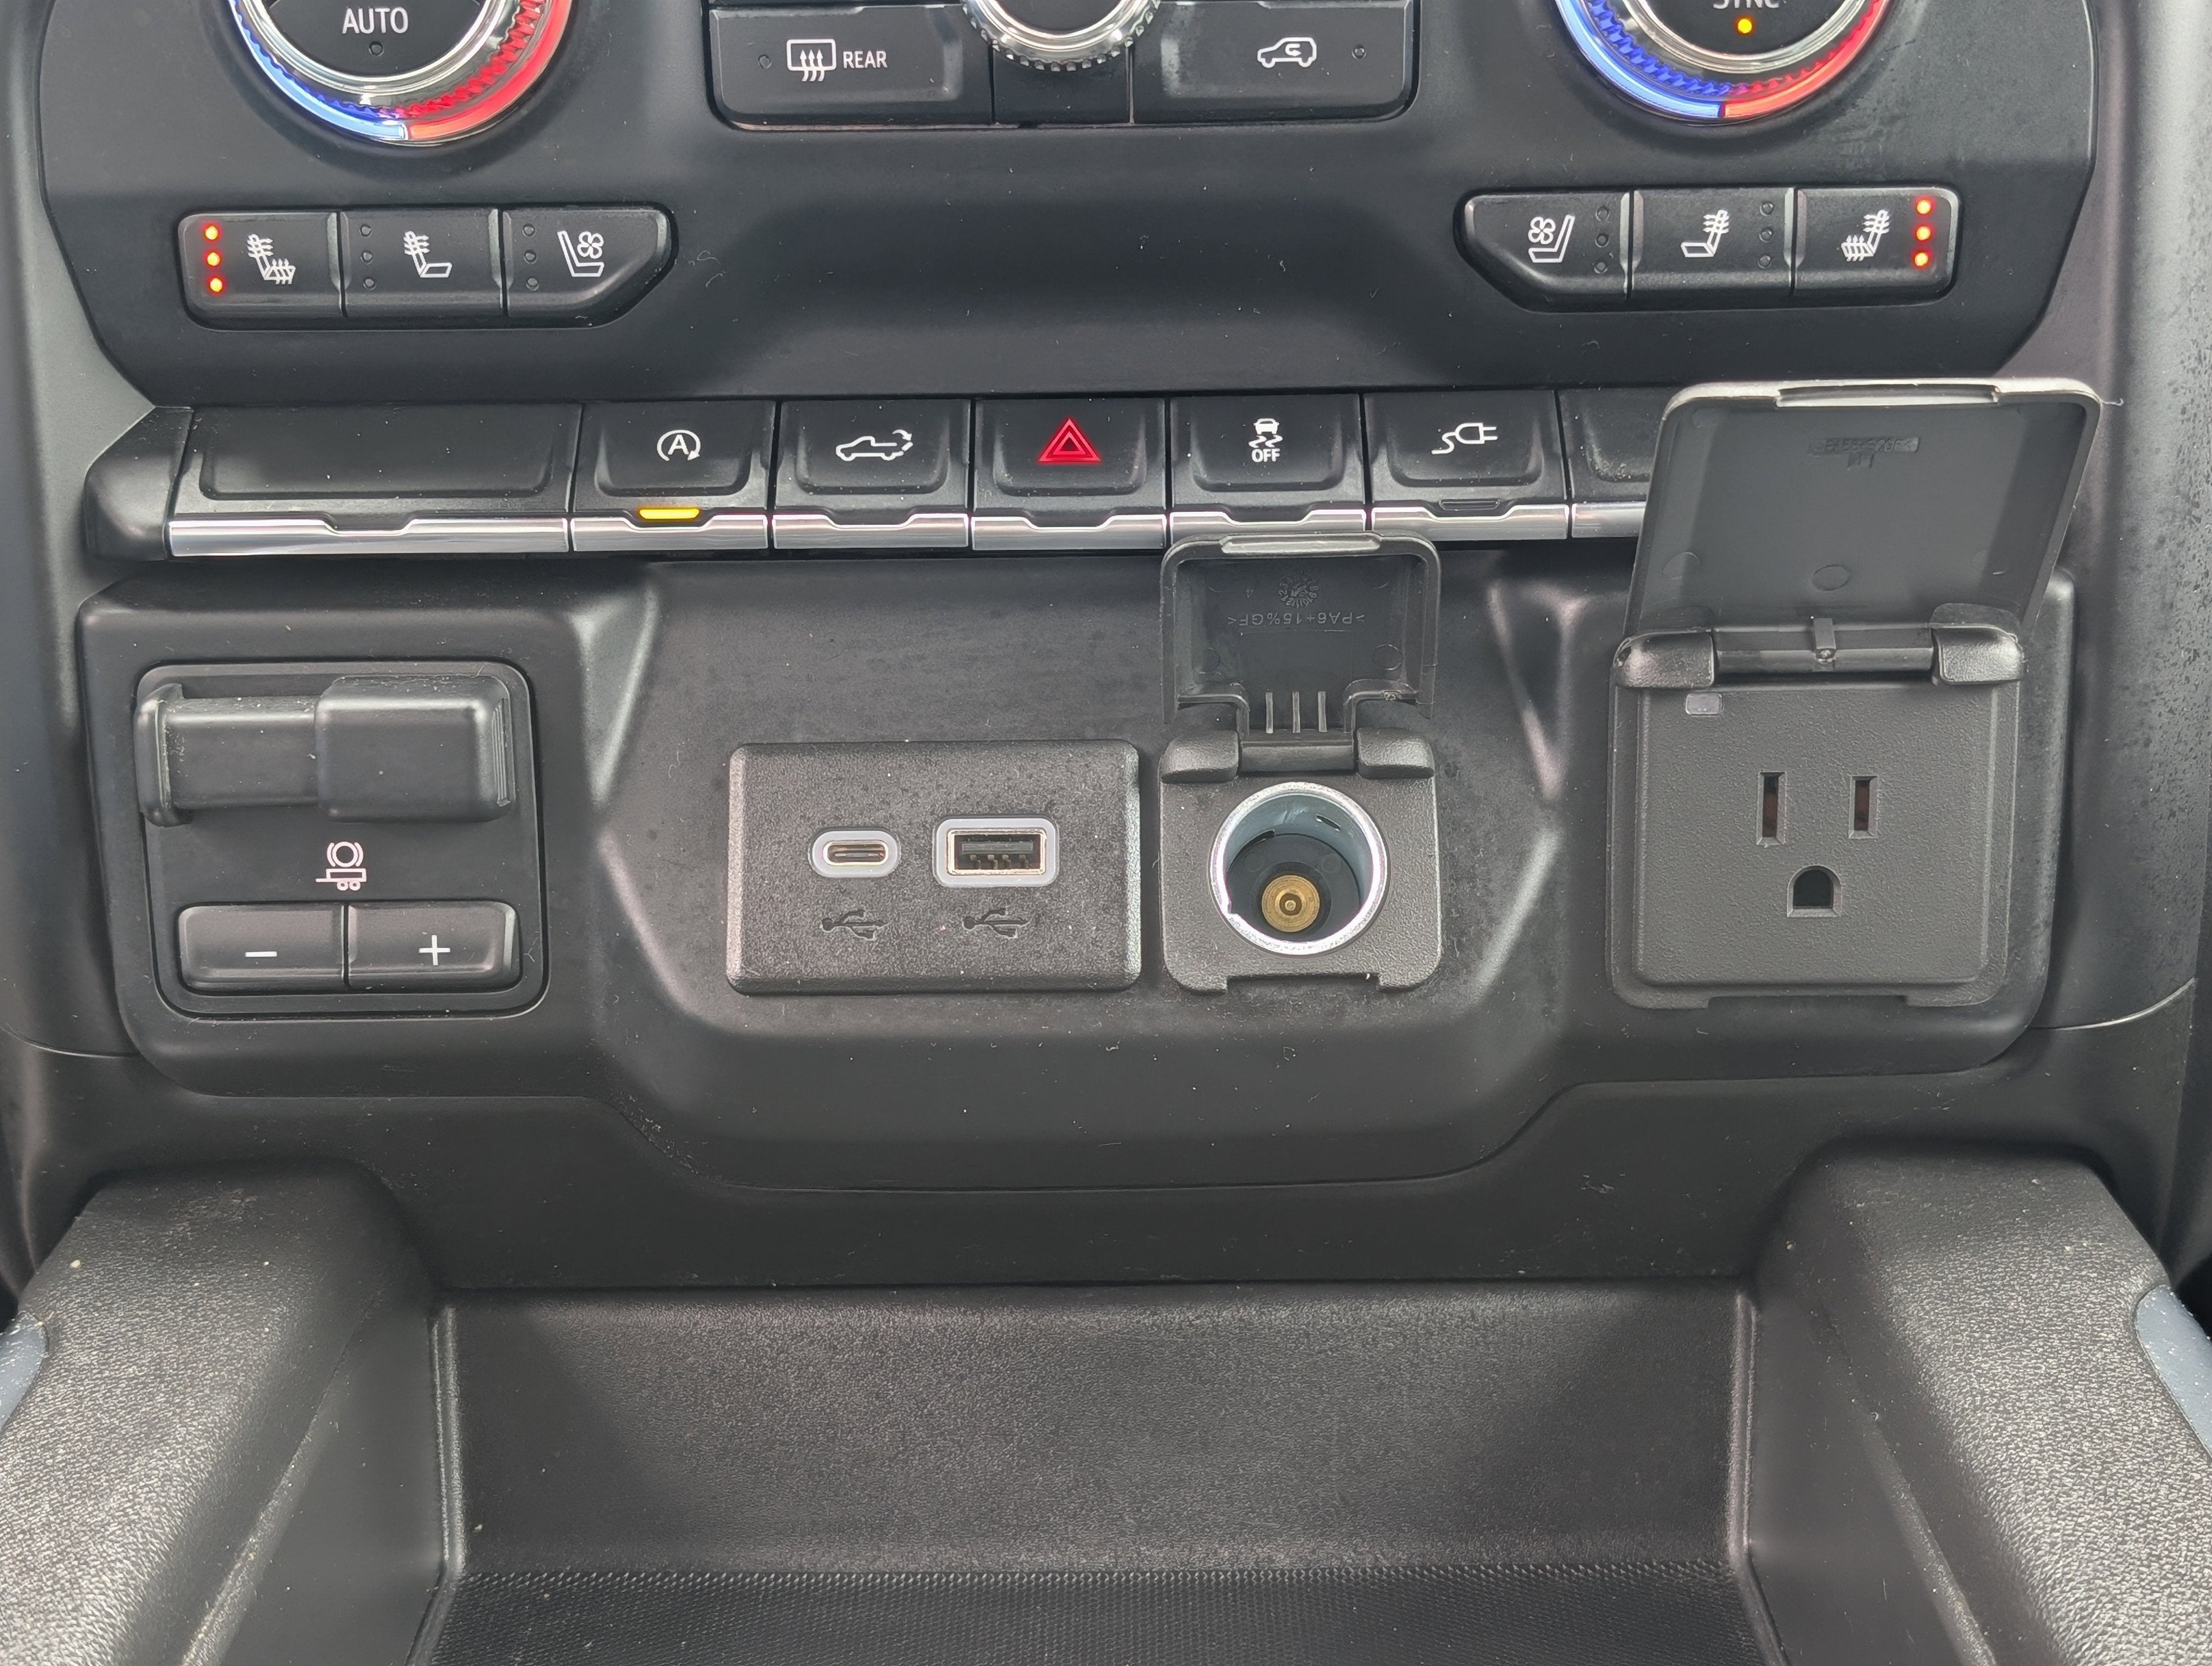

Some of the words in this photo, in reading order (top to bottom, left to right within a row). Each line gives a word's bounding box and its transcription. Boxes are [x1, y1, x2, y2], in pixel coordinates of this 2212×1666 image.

[342, 7, 409, 34] AUTO
[843, 50, 888, 69] REAR
[1251, 448, 1281, 463] OFF
